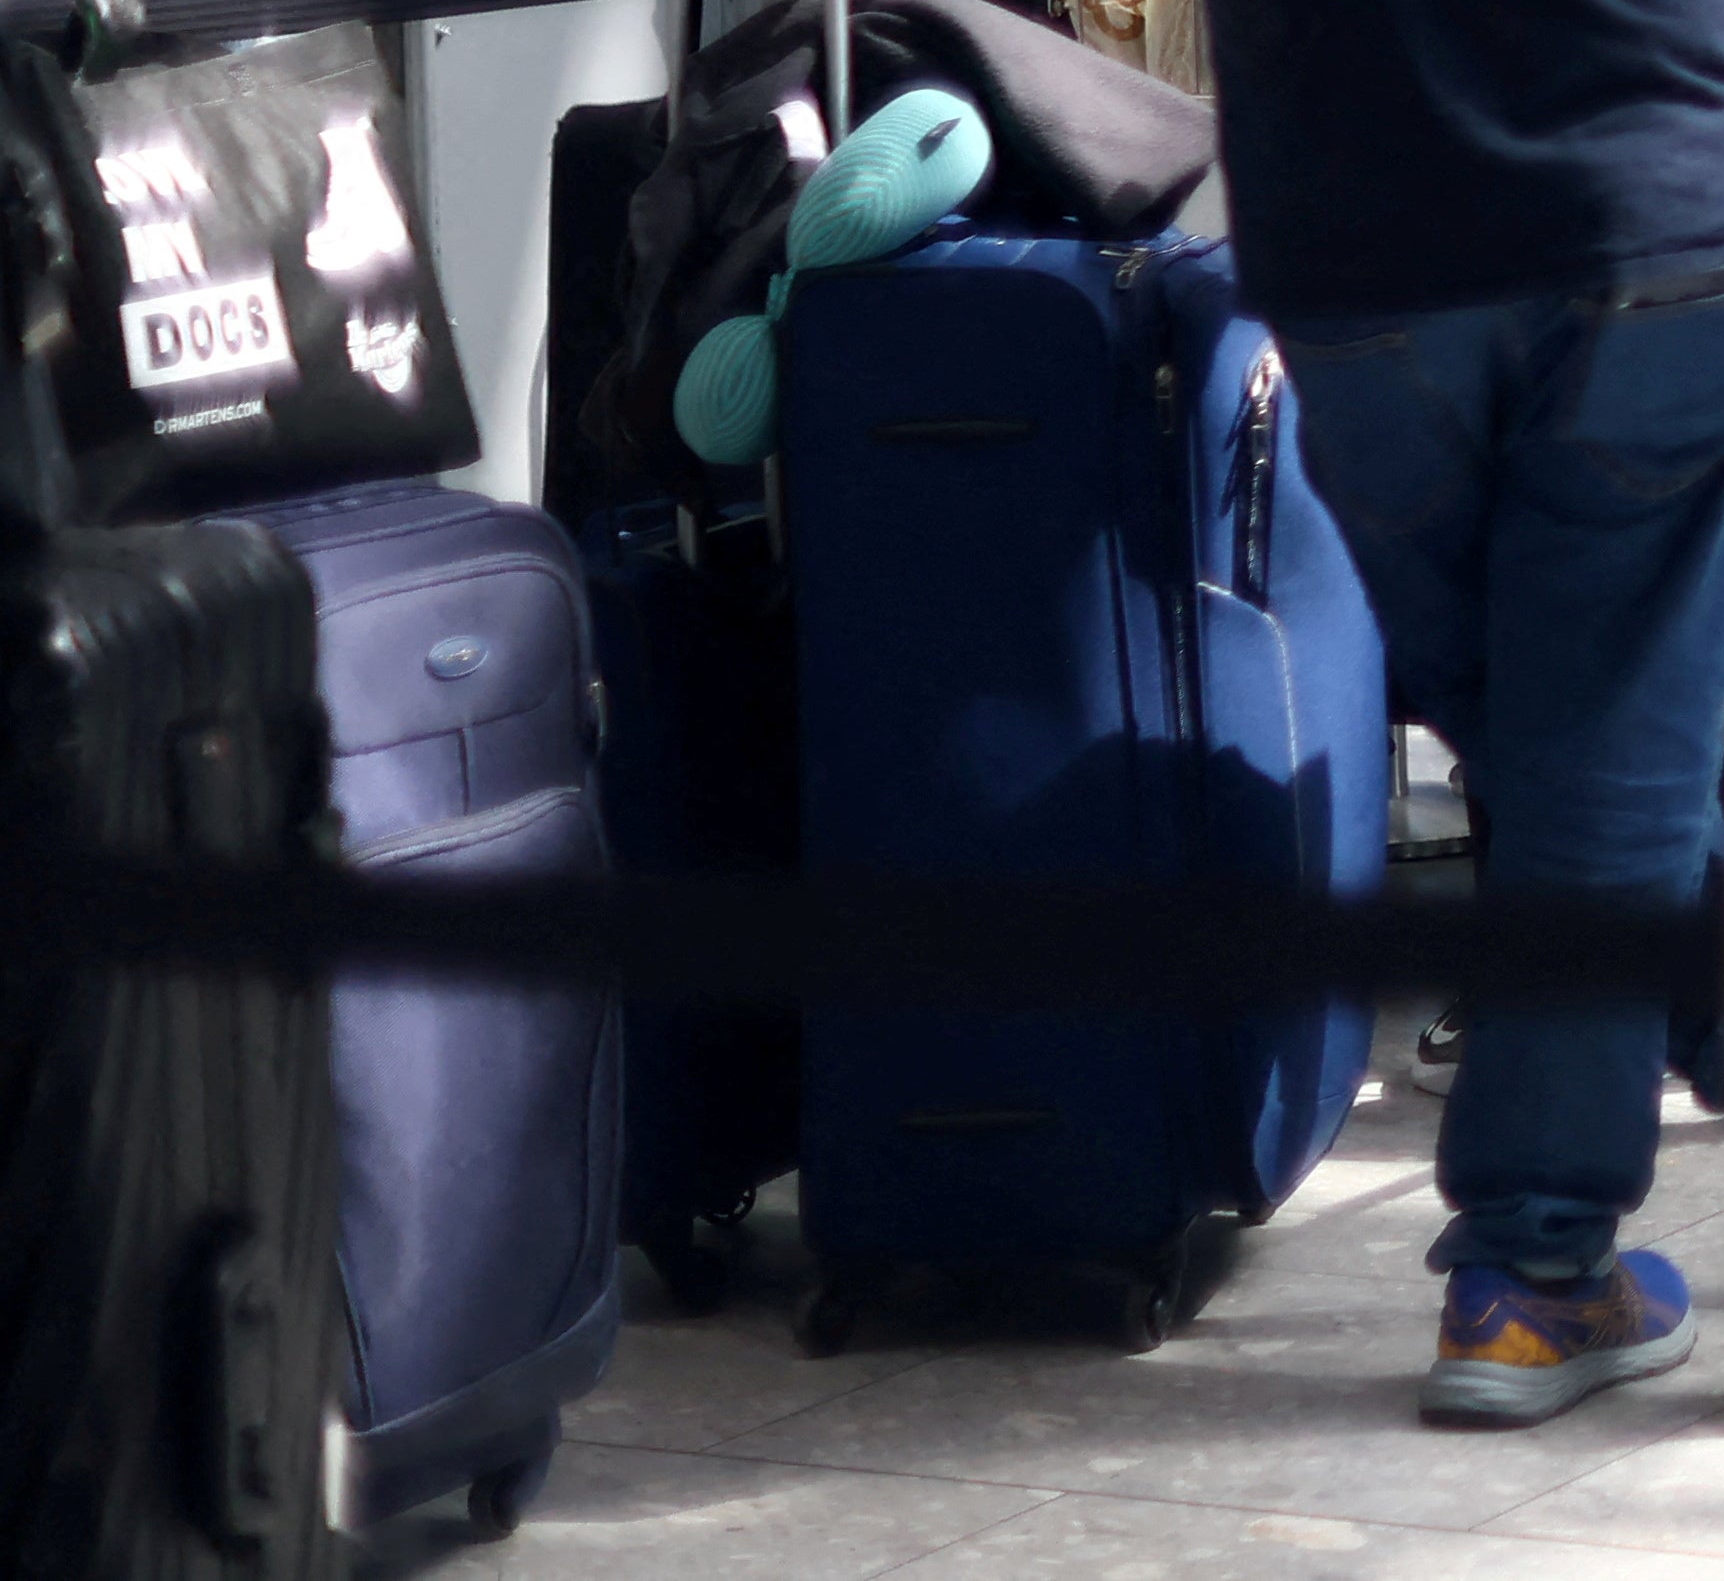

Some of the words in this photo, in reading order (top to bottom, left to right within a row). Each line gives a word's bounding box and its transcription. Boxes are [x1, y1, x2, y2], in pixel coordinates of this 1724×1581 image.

[121, 220, 206, 282] MY
[143, 293, 270, 371] DOCS
[153, 399, 264, 435] DRMARTENS.COM
